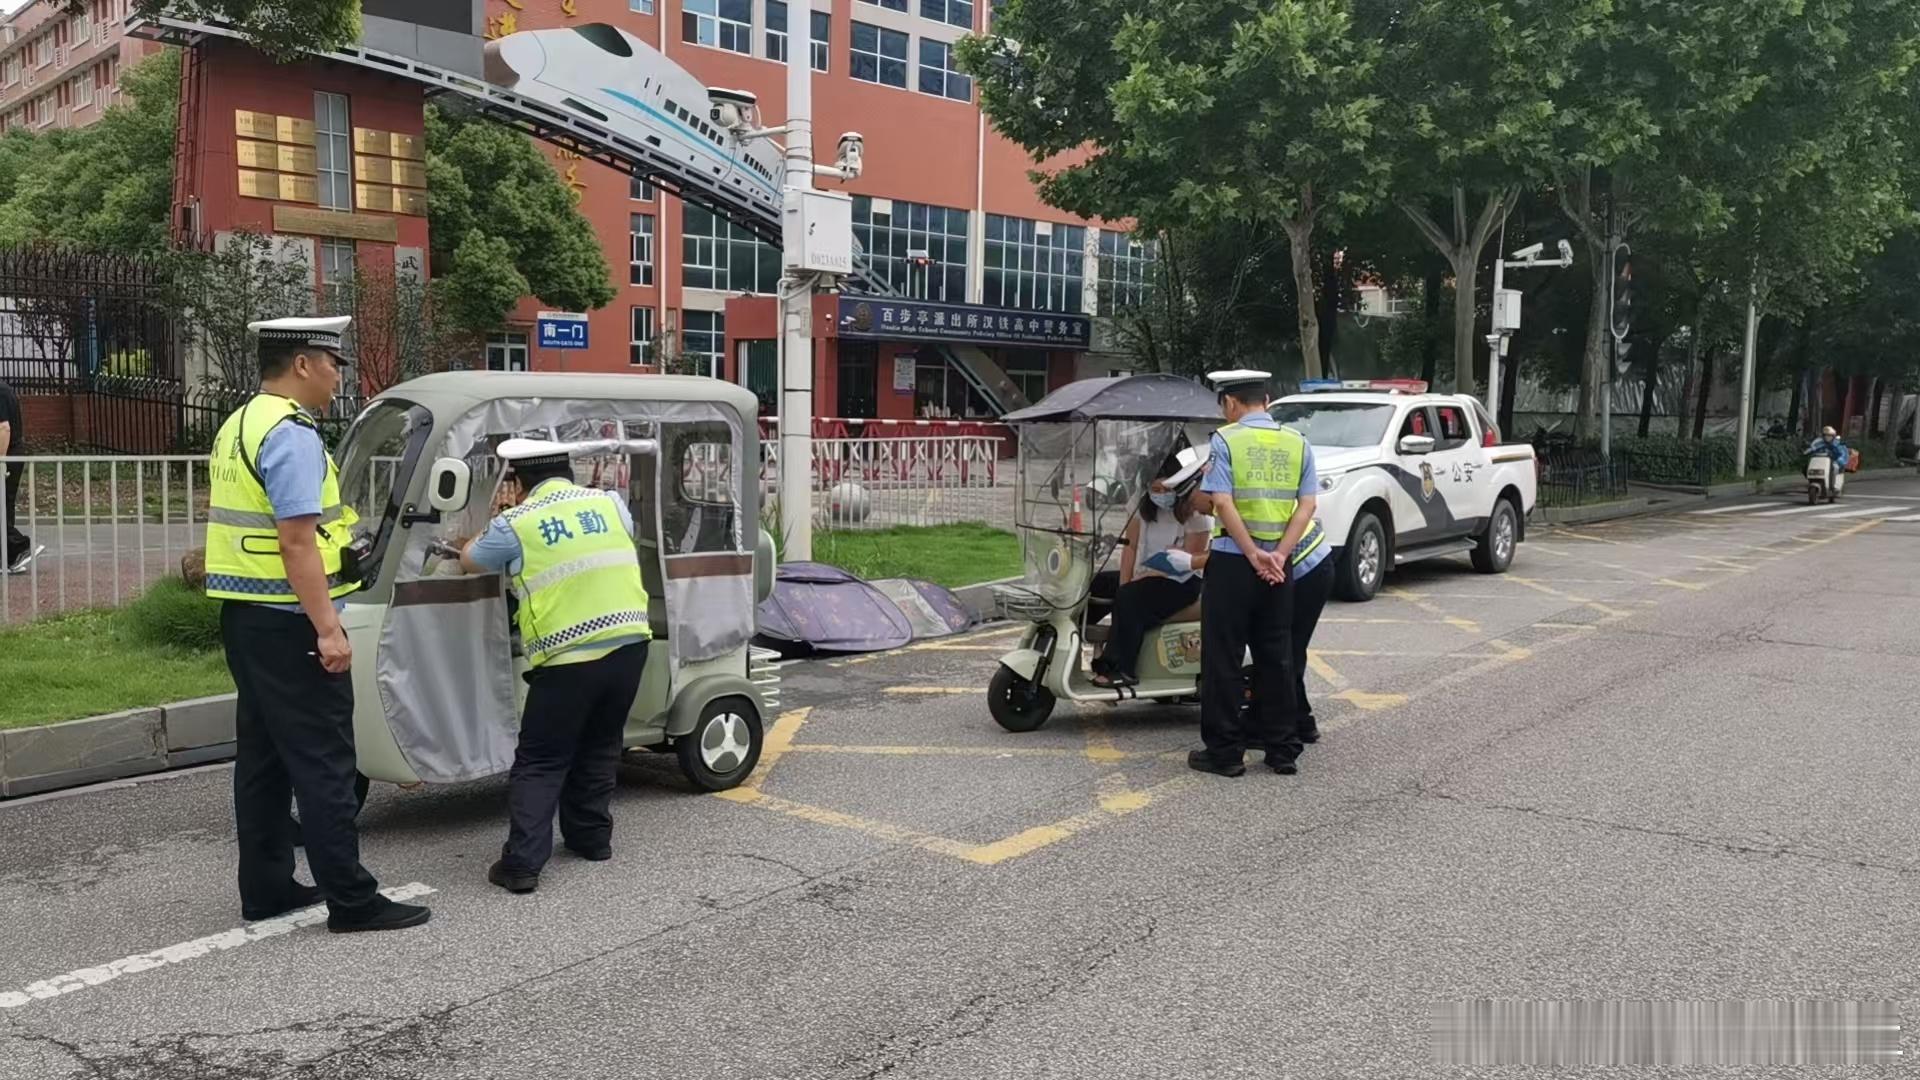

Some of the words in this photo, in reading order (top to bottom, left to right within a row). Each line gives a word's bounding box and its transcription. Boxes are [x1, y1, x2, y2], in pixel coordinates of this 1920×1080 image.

[543, 322, 584, 339] 南一门
[881, 307, 1083, 336] 百步亭派出所汉铁高中警务室
[1246, 446, 1290, 471] 警察
[1246, 471, 1292, 483] POLICE
[1452, 462, 1474, 483] 公安
[538, 509, 608, 546] 执勤
